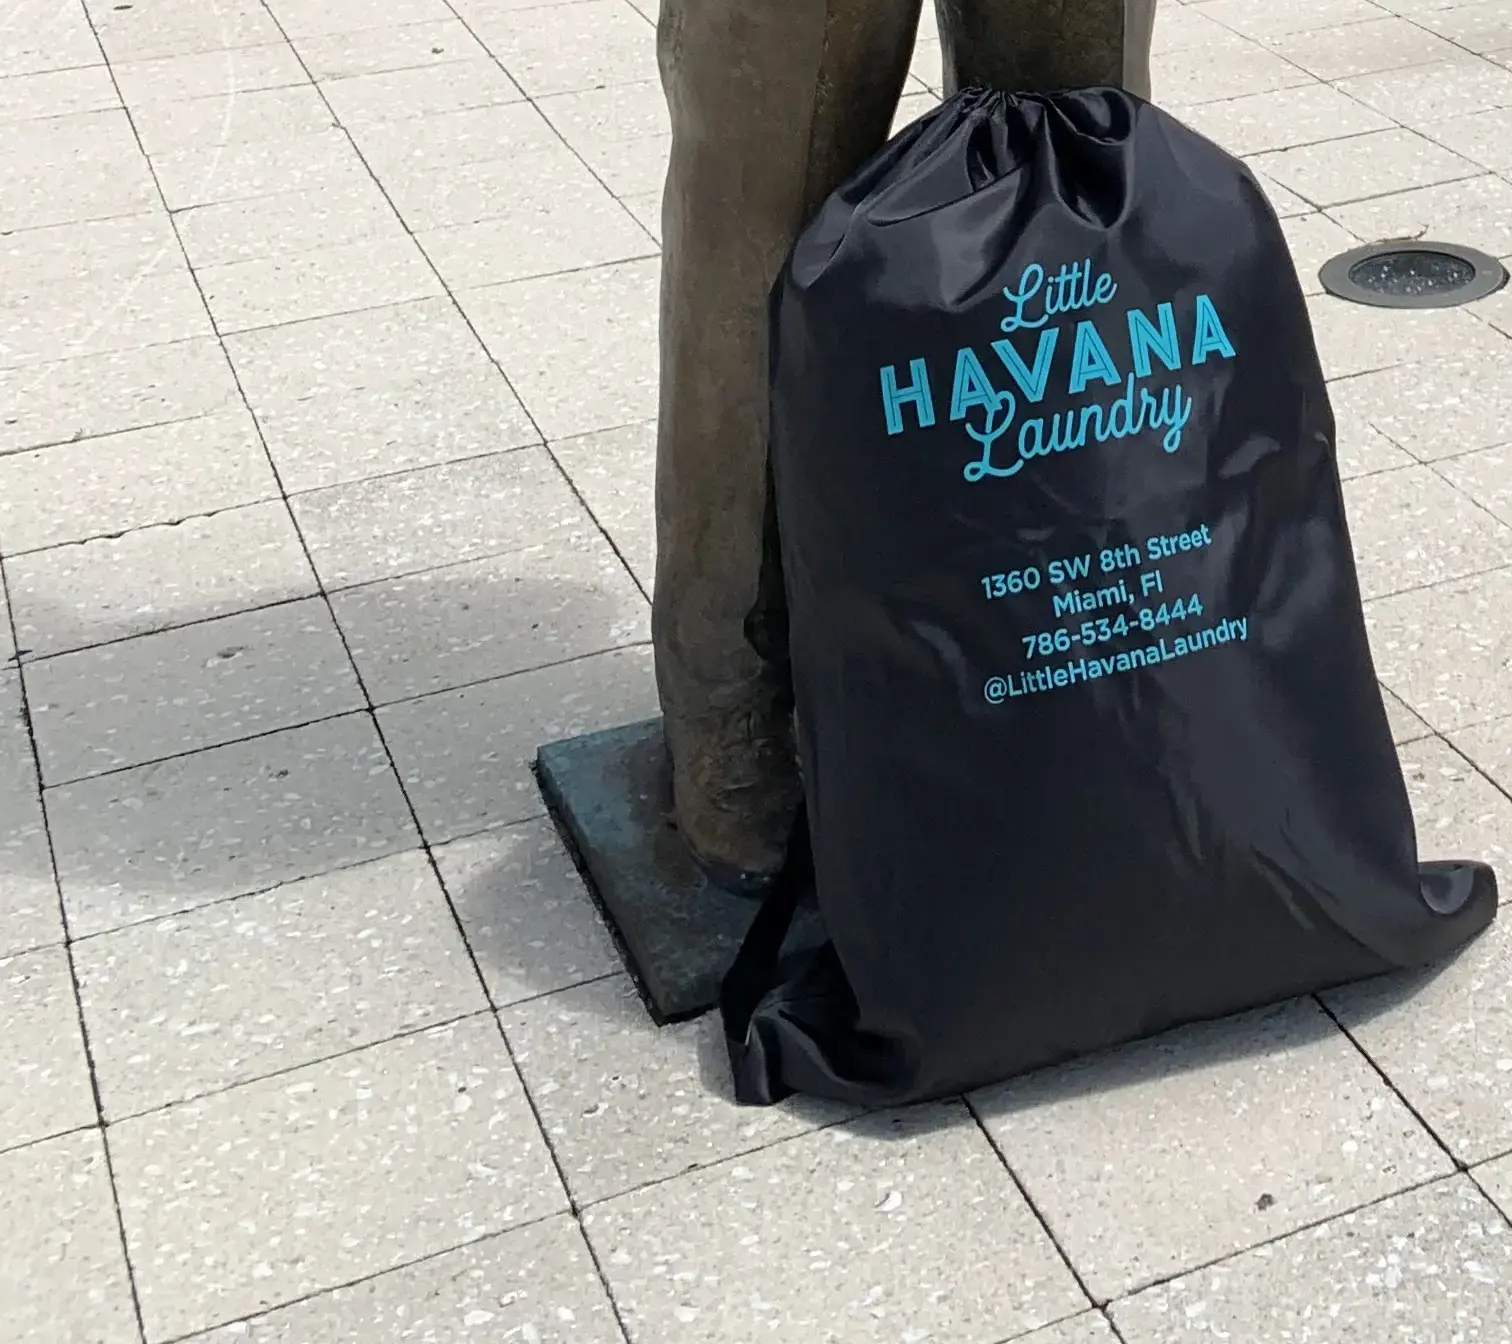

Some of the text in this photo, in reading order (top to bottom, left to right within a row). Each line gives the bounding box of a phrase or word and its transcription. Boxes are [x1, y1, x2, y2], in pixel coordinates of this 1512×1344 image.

[1000, 258, 1117, 333] Little
[880, 294, 1236, 435] HAVANA
[963, 372, 1192, 482] Laundry
[981, 523, 1213, 600] 1360 SW 8th Street
[1053, 579, 1135, 618] Miami,
[984, 616, 1248, 704] @LittleHavanaLaundry
[1022, 593, 1204, 660] 786-534-8444
